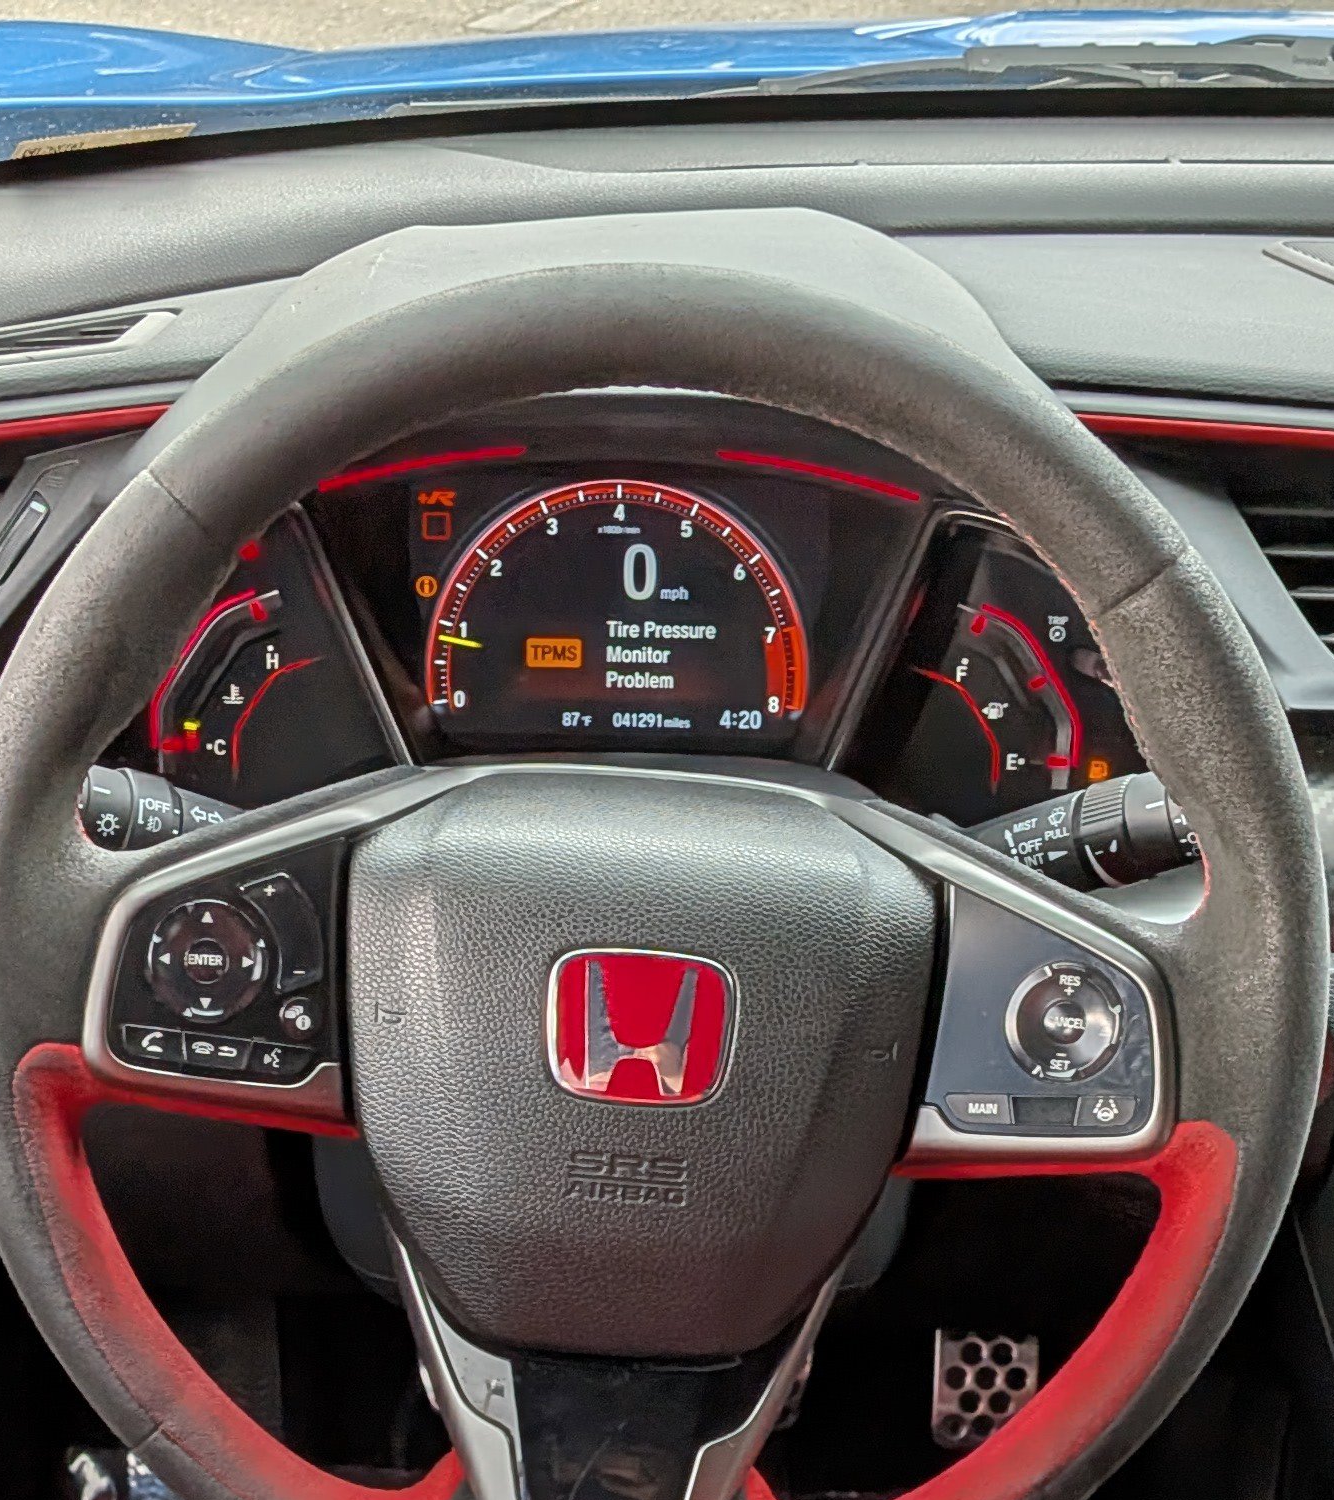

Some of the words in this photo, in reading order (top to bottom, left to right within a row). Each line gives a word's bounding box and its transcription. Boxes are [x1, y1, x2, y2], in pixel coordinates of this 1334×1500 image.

[613, 504, 625, 521] 4
[546, 517, 558, 535] 3
[680, 520, 692, 537] 5
[490, 559, 502, 576] 2
[623, 543, 657, 600] 0
[660, 586, 689, 601] mph
[733, 563, 746, 581] 6
[459, 621, 467, 638] 1
[606, 621, 640, 638] Tire
[644, 622, 716, 639] Pressure
[764, 627, 775, 643] 7
[266, 652, 280, 670] H
[530, 645, 578, 661] TPMS
[606, 646, 671, 663] Monitor
[606, 671, 674, 688] Problem
[955, 665, 968, 682] F
[453, 690, 466, 708] 0
[768, 696, 779, 713] 8
[612, 712, 663, 728] 041291
[720, 709, 763, 729] 4:20
[213, 738, 227, 756] C
[1005, 753, 1019, 770] E
[145, 797, 172, 814] OFF
[1012, 817, 1038, 833] MIST
[1044, 826, 1070, 841] PULL
[1017, 837, 1043, 855] OFF
[187, 953, 224, 967] ENTER
[1058, 974, 1082, 987] RES
[1049, 1058, 1072, 1071] SET
[967, 1102, 998, 1115] MAIN
[567, 1150, 689, 1183] SRS
[565, 1180, 688, 1207] AIRBAG
